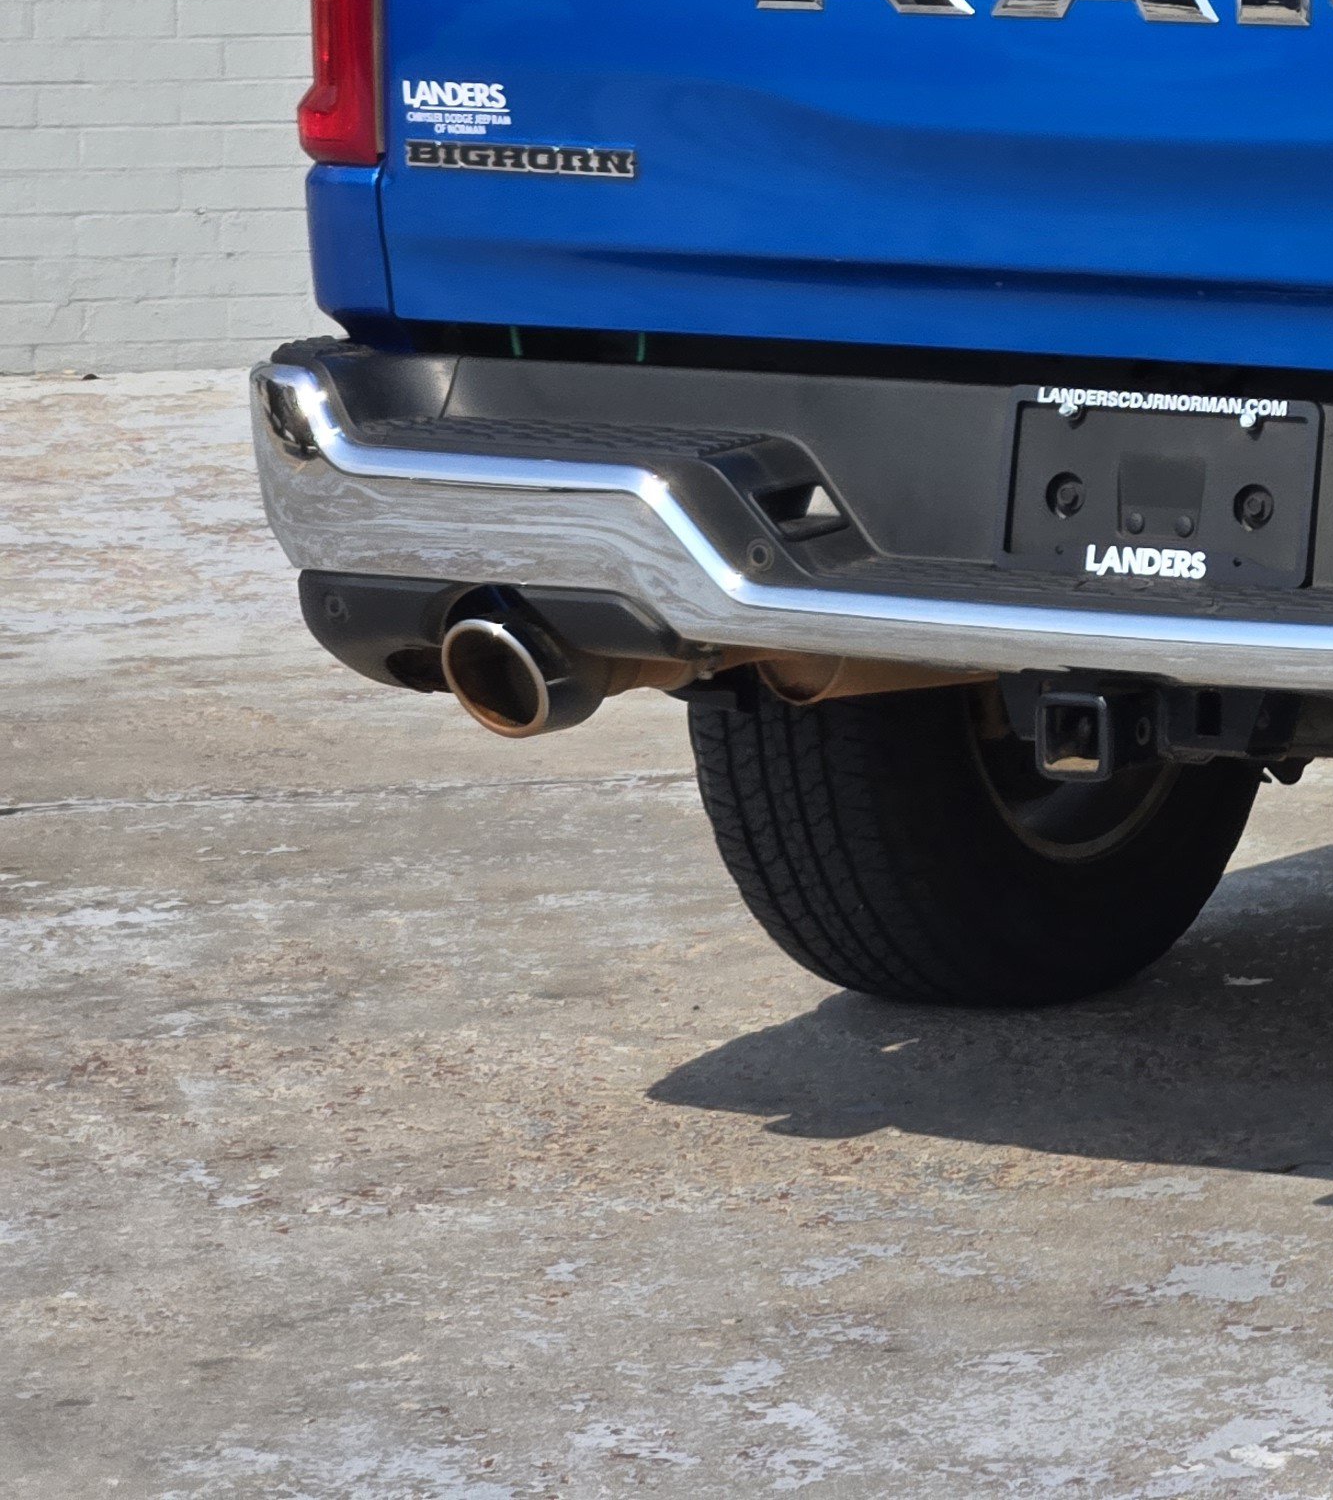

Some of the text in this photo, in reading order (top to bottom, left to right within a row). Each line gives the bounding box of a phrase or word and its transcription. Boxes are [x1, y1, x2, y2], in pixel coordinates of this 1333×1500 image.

[402, 80, 507, 108] LANDERS
[434, 124, 486, 135] OF NORMAN
[444, 113, 474, 124] DODGE
[406, 140, 634, 177] BIGHORN
[1037, 386, 1288, 417] LANDERSCDJRNORMAN.COM
[1085, 544, 1207, 580] LANDERS
